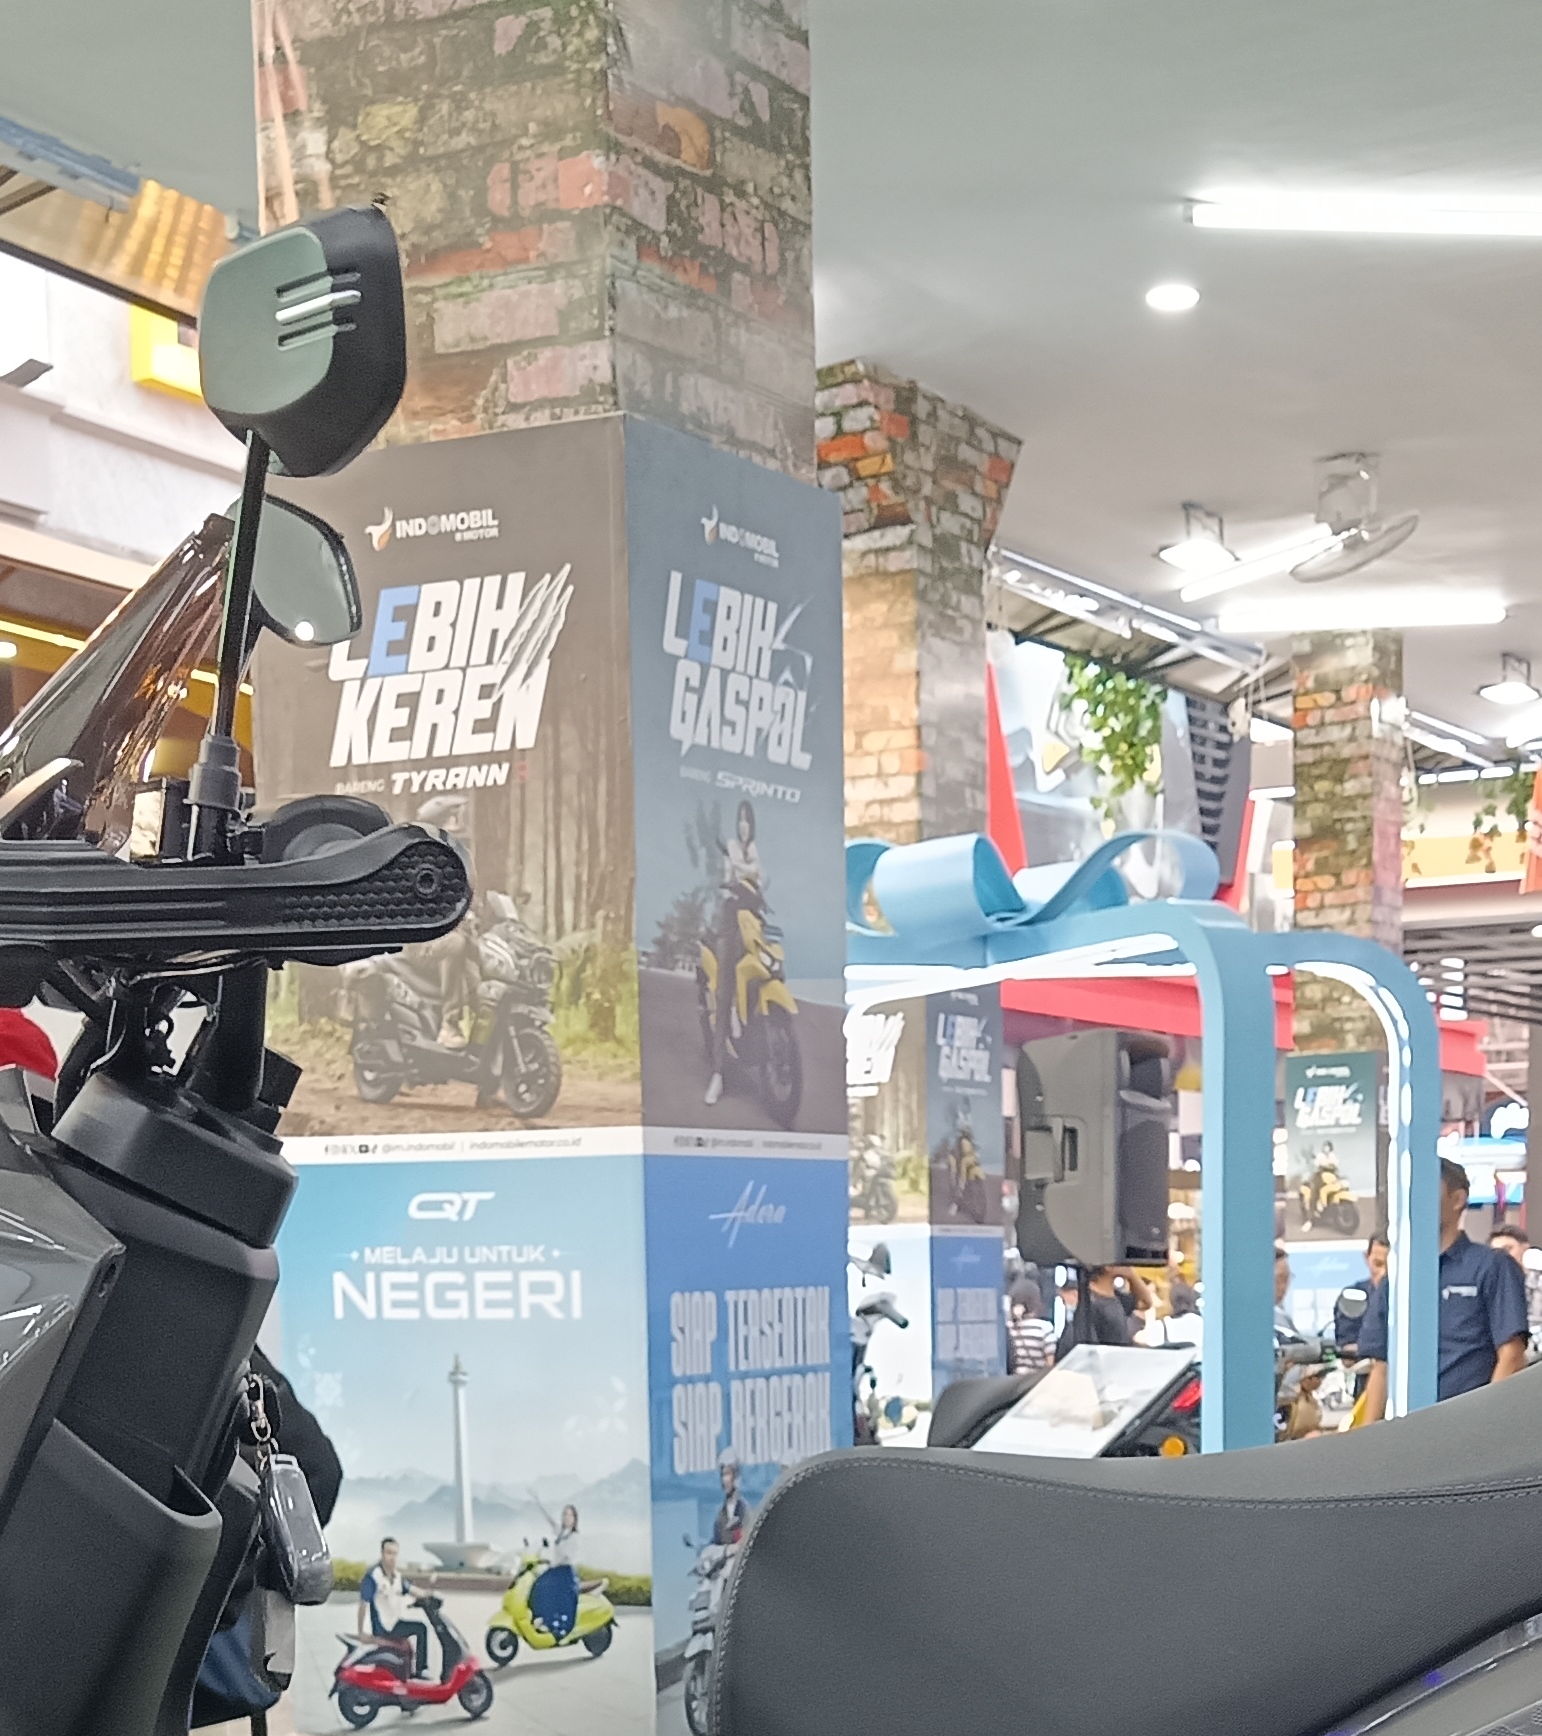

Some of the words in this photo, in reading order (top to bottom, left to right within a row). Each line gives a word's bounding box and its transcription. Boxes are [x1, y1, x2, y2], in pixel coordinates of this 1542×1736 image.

[396, 509, 499, 538] INDOMOBIL
[328, 571, 527, 680] LEBIH
[662, 570, 779, 680] LEBIH
[329, 658, 550, 768] KEREN
[669, 658, 813, 772] GASPOL
[391, 762, 510, 795] TYRANN
[715, 770, 802, 803] SPRINTO
[1294, 1085, 1347, 1110] LEBIH
[1295, 1102, 1363, 1129] GASPOL
[407, 1190, 496, 1221] QT
[363, 1246, 458, 1265] MELAJU
[464, 1244, 546, 1263] UNTUK
[332, 1269, 583, 1321] NEGERI
[670, 1290, 718, 1377] SIAP
[672, 1381, 722, 1475] SIAP
